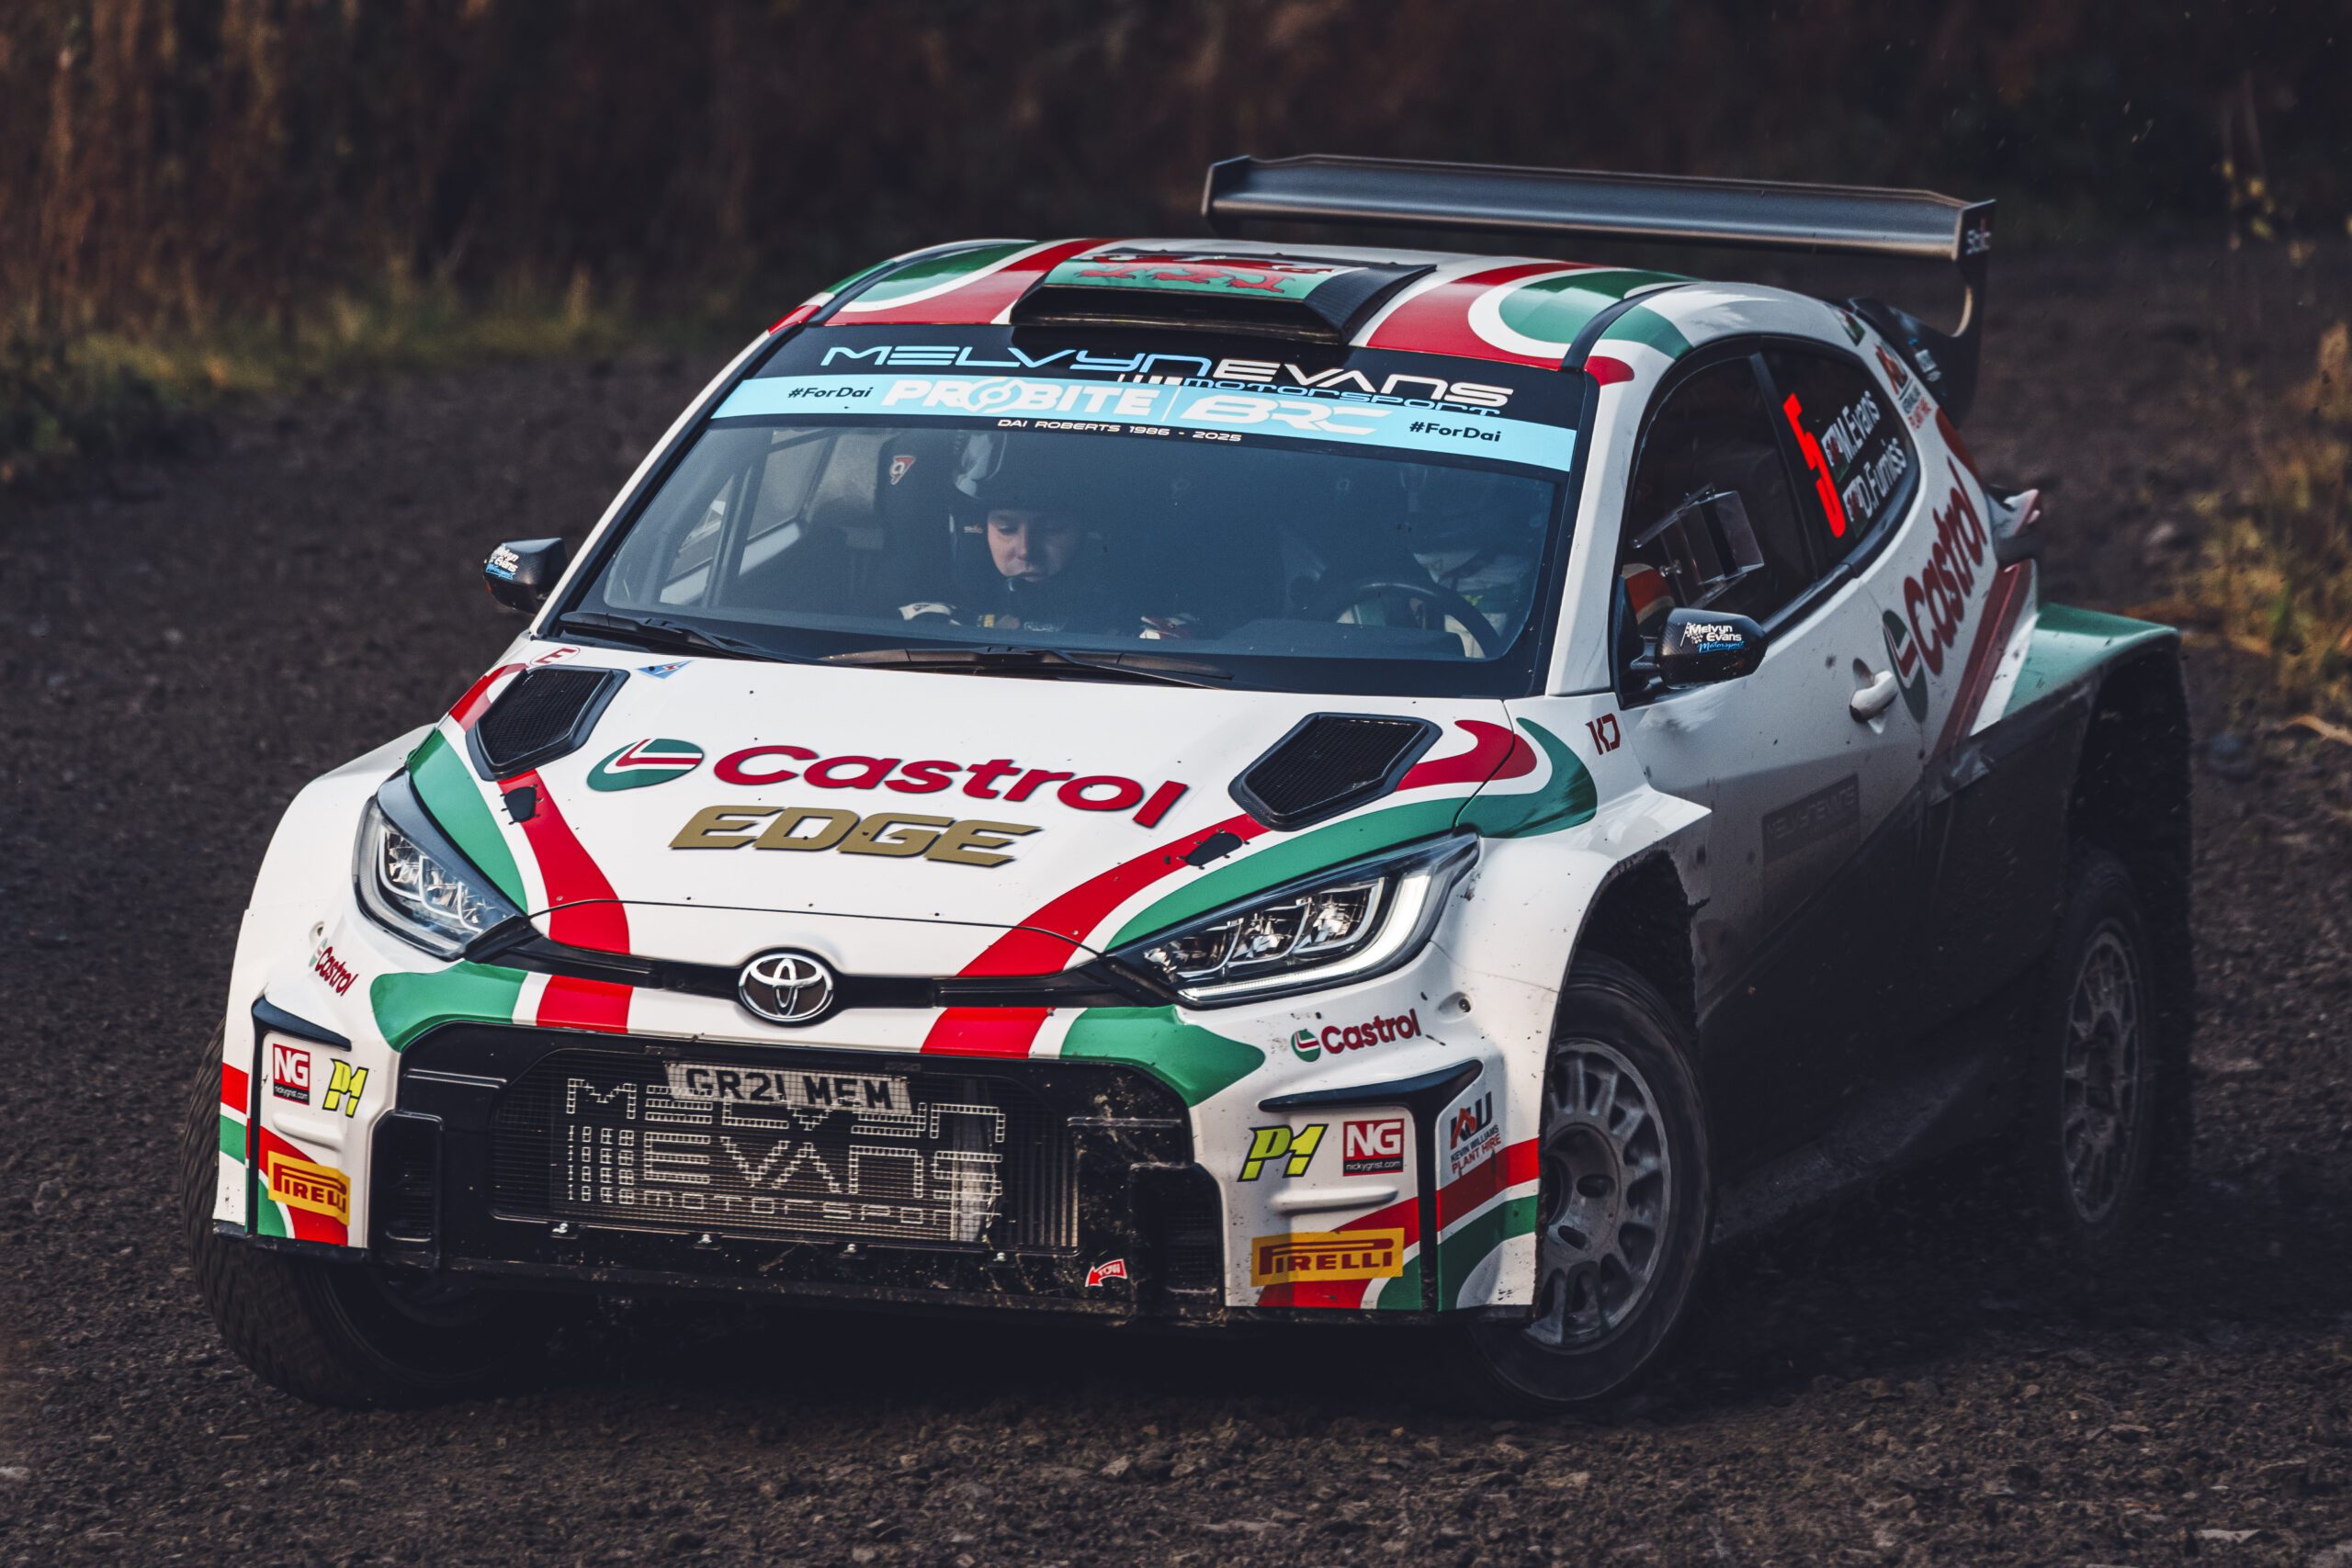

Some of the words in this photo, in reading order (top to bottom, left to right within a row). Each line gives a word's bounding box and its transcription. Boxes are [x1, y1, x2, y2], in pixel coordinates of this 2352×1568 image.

[787, 387, 874, 400] #ForDai
[1182, 378, 1500, 417] MOTORSPORT
[1213, 358, 1514, 407] EVANS
[998, 419, 1028, 428] DAI
[1035, 421, 1121, 433] ROBERTS
[1128, 425, 1170, 437] 1986
[1193, 431, 1242, 442] 2025
[1180, 394, 1395, 435] BRC
[1409, 421, 1502, 443] #ForDai
[1782, 392, 1846, 538] 5
[1903, 457, 1988, 676] Castrol
[1689, 624, 1734, 636] Melvyn
[1705, 632, 1742, 642] Evans
[713, 744, 1189, 828] Castrol
[667, 805, 1046, 868] EDGE
[314, 946, 359, 997] Castrol
[1321, 1009, 1421, 1054] Castrol
[275, 1047, 309, 1088] NG
[685, 1068, 787, 1100] GR21
[803, 1075, 894, 1111] MEM
[1346, 1122, 1401, 1157] NG
[1452, 1147, 1479, 1174] PLANT
[1481, 1133, 1502, 1154] HIRE
[272, 1162, 347, 1214] PIRELLI
[1259, 1238, 1395, 1276] PIRELLI
